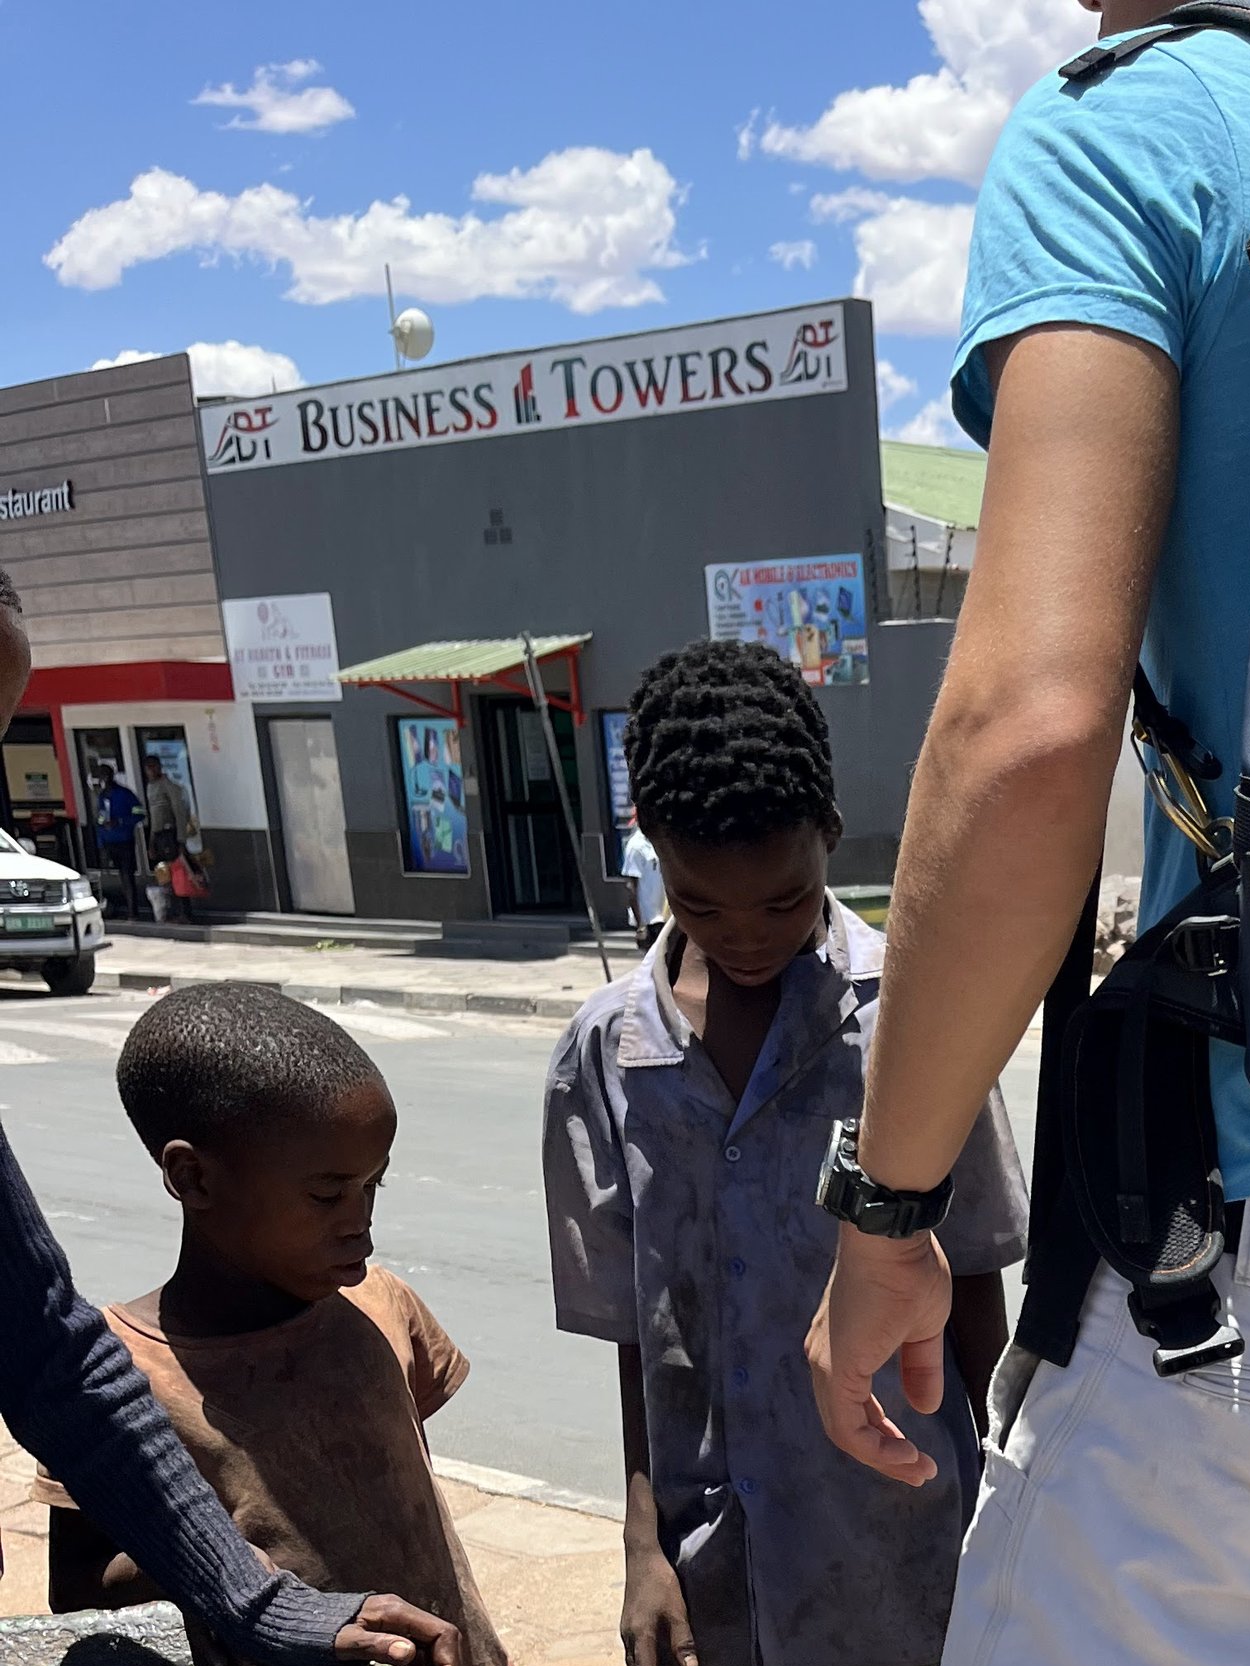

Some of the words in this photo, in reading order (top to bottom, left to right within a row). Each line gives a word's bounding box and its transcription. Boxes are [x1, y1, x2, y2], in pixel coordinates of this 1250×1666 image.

[297, 382, 498, 453] BUSINESS
[550, 341, 773, 419] TOWERS
[0, 479, 71, 520] staurant
